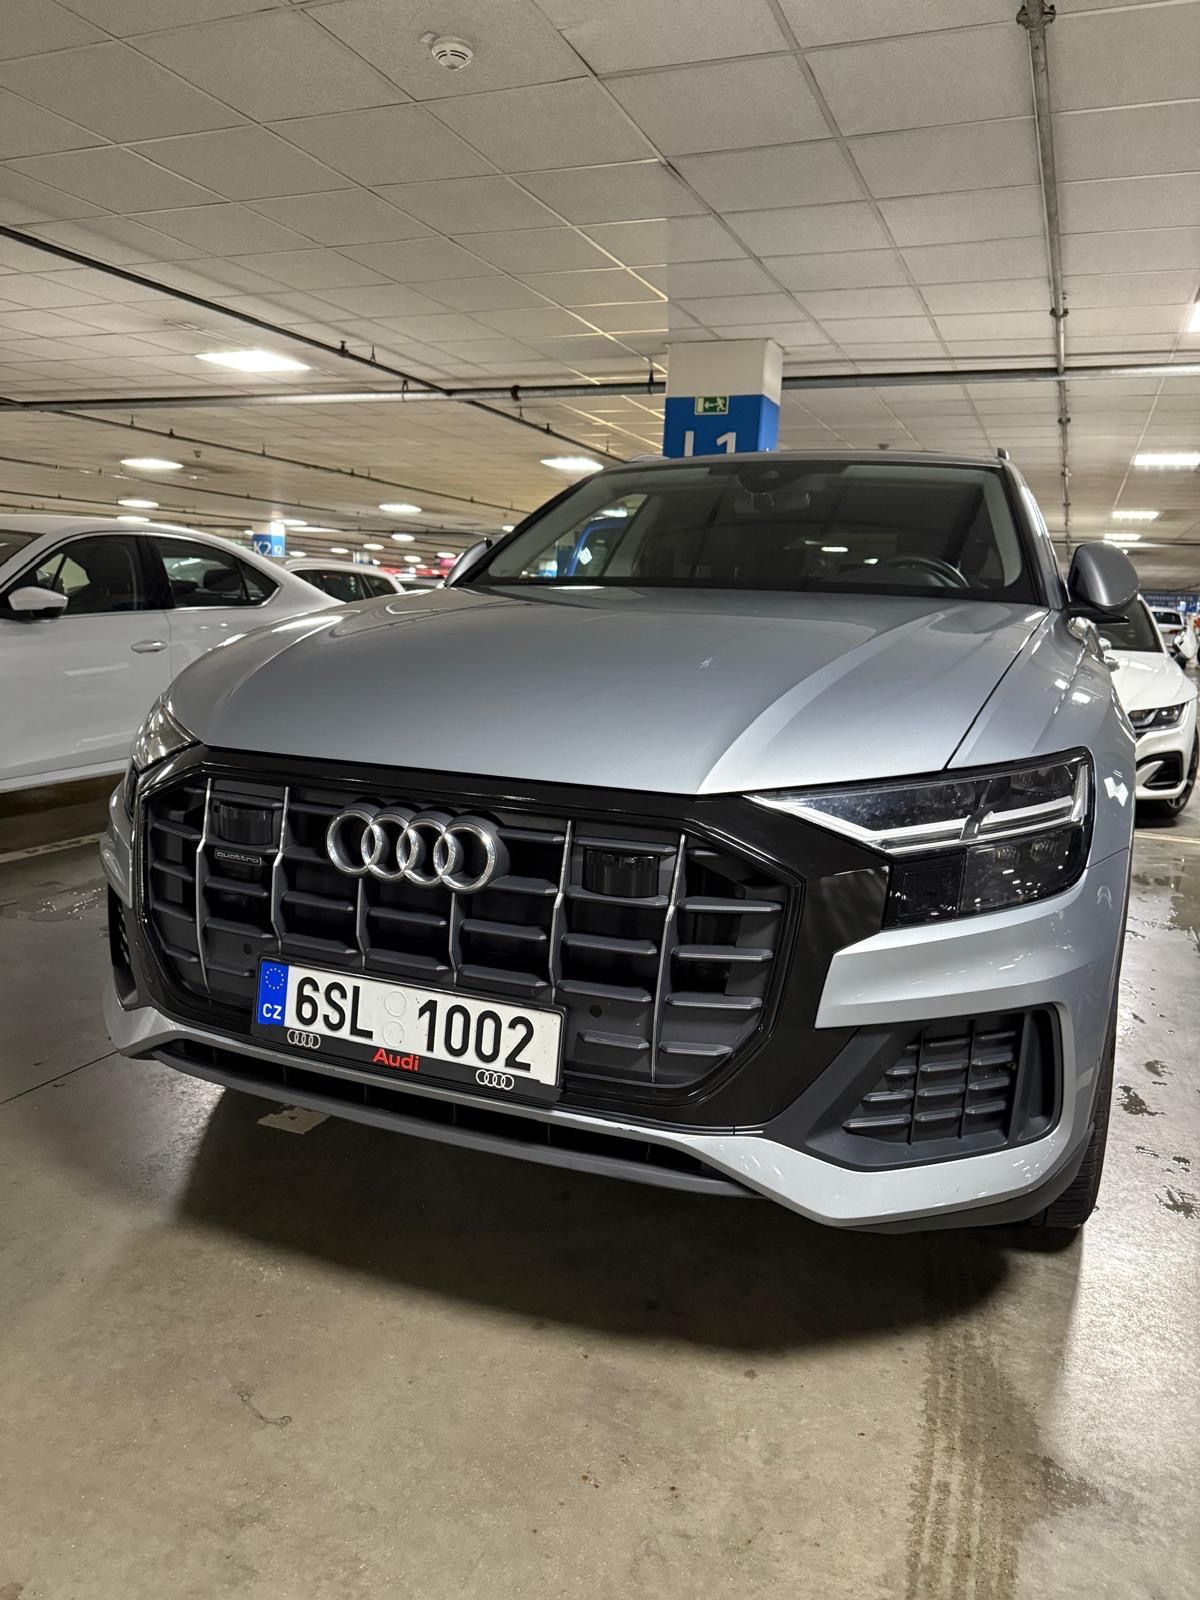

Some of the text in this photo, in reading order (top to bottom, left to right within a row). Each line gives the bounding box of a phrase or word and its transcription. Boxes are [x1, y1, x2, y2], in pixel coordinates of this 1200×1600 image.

[253, 541, 272, 556] K2
[216, 851, 260, 864] quattro
[262, 1003, 283, 1021] CZ
[295, 976, 535, 1073] 6SL 1002
[372, 1047, 421, 1072] Audi
